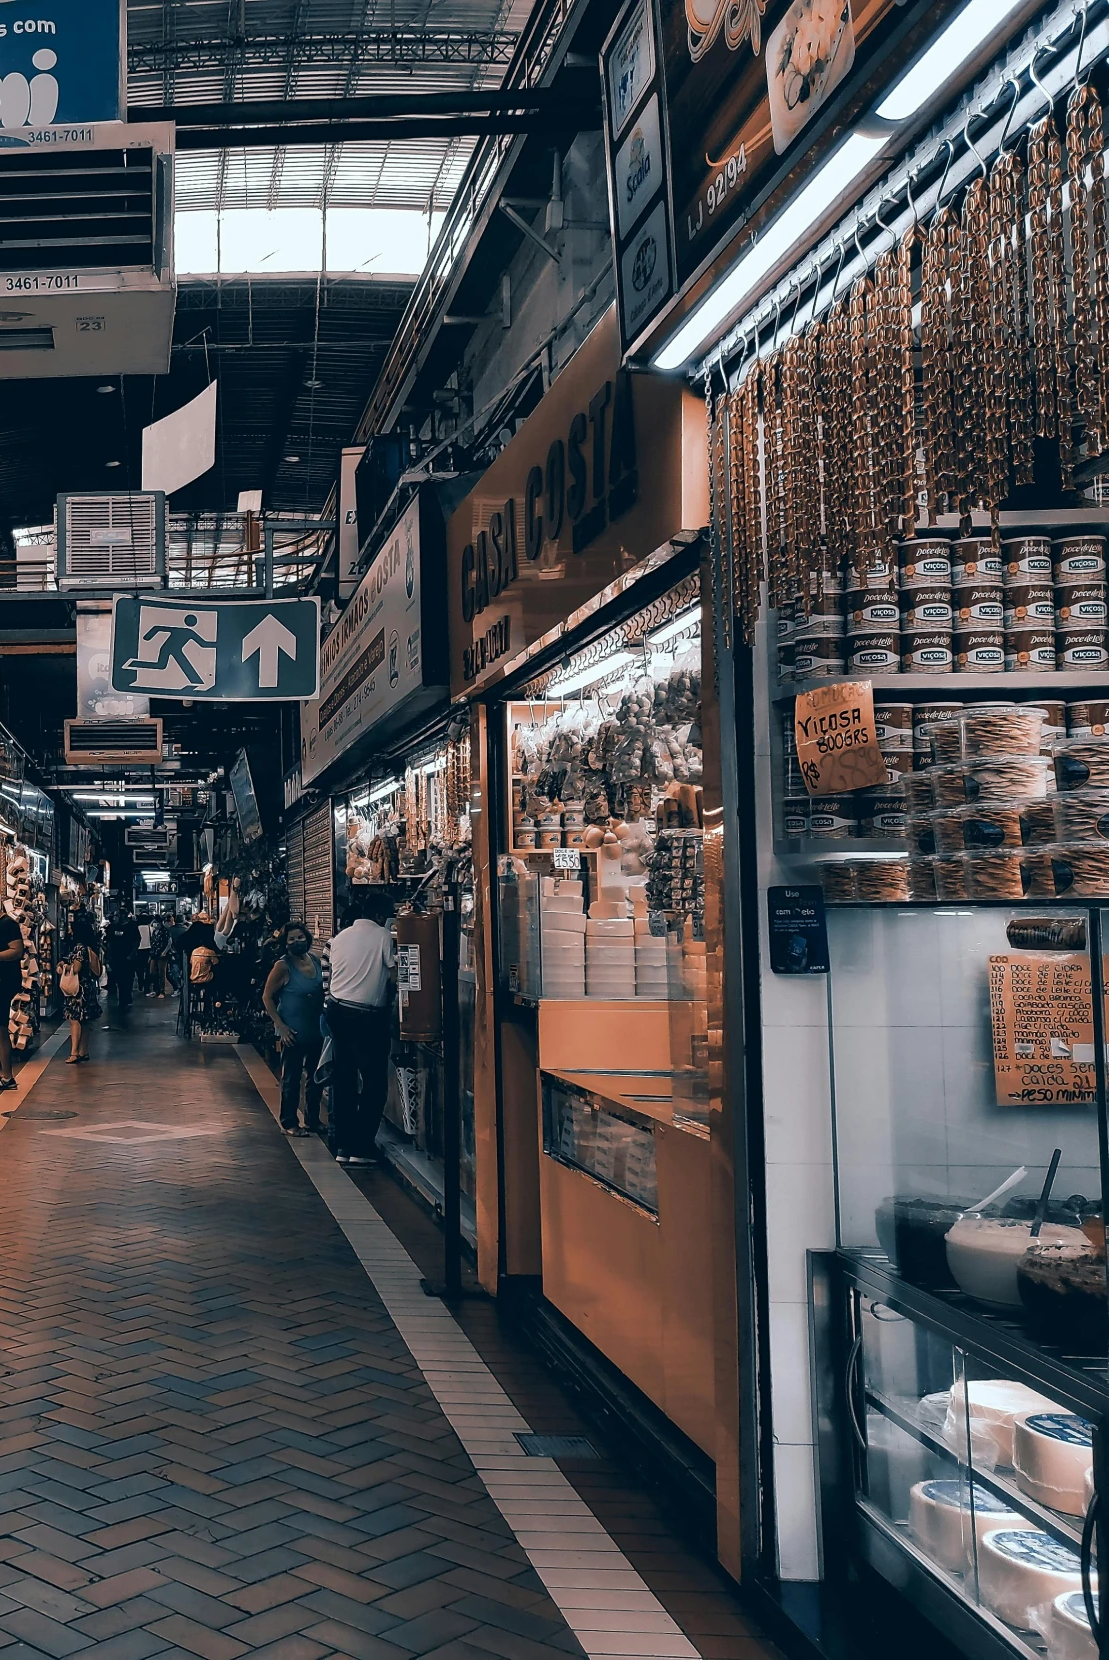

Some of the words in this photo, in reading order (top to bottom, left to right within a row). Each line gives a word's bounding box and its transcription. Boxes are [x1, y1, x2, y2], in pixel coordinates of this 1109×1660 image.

[13, 18, 56, 35] com
[27, 129, 92, 144] 3461-7011
[626, 153, 651, 202] Scala
[706, 142, 748, 207] 92/94
[5, 275, 80, 291] 3461-7011
[80, 322, 102, 331] 23
[461, 498, 519, 624] CASA
[524, 373, 638, 561] COSTA
[341, 594, 369, 654] IRMÃOS
[816, 727, 869, 754] 800GRS
[801, 759, 821, 790] R$
[785, 890, 800, 898] Use
